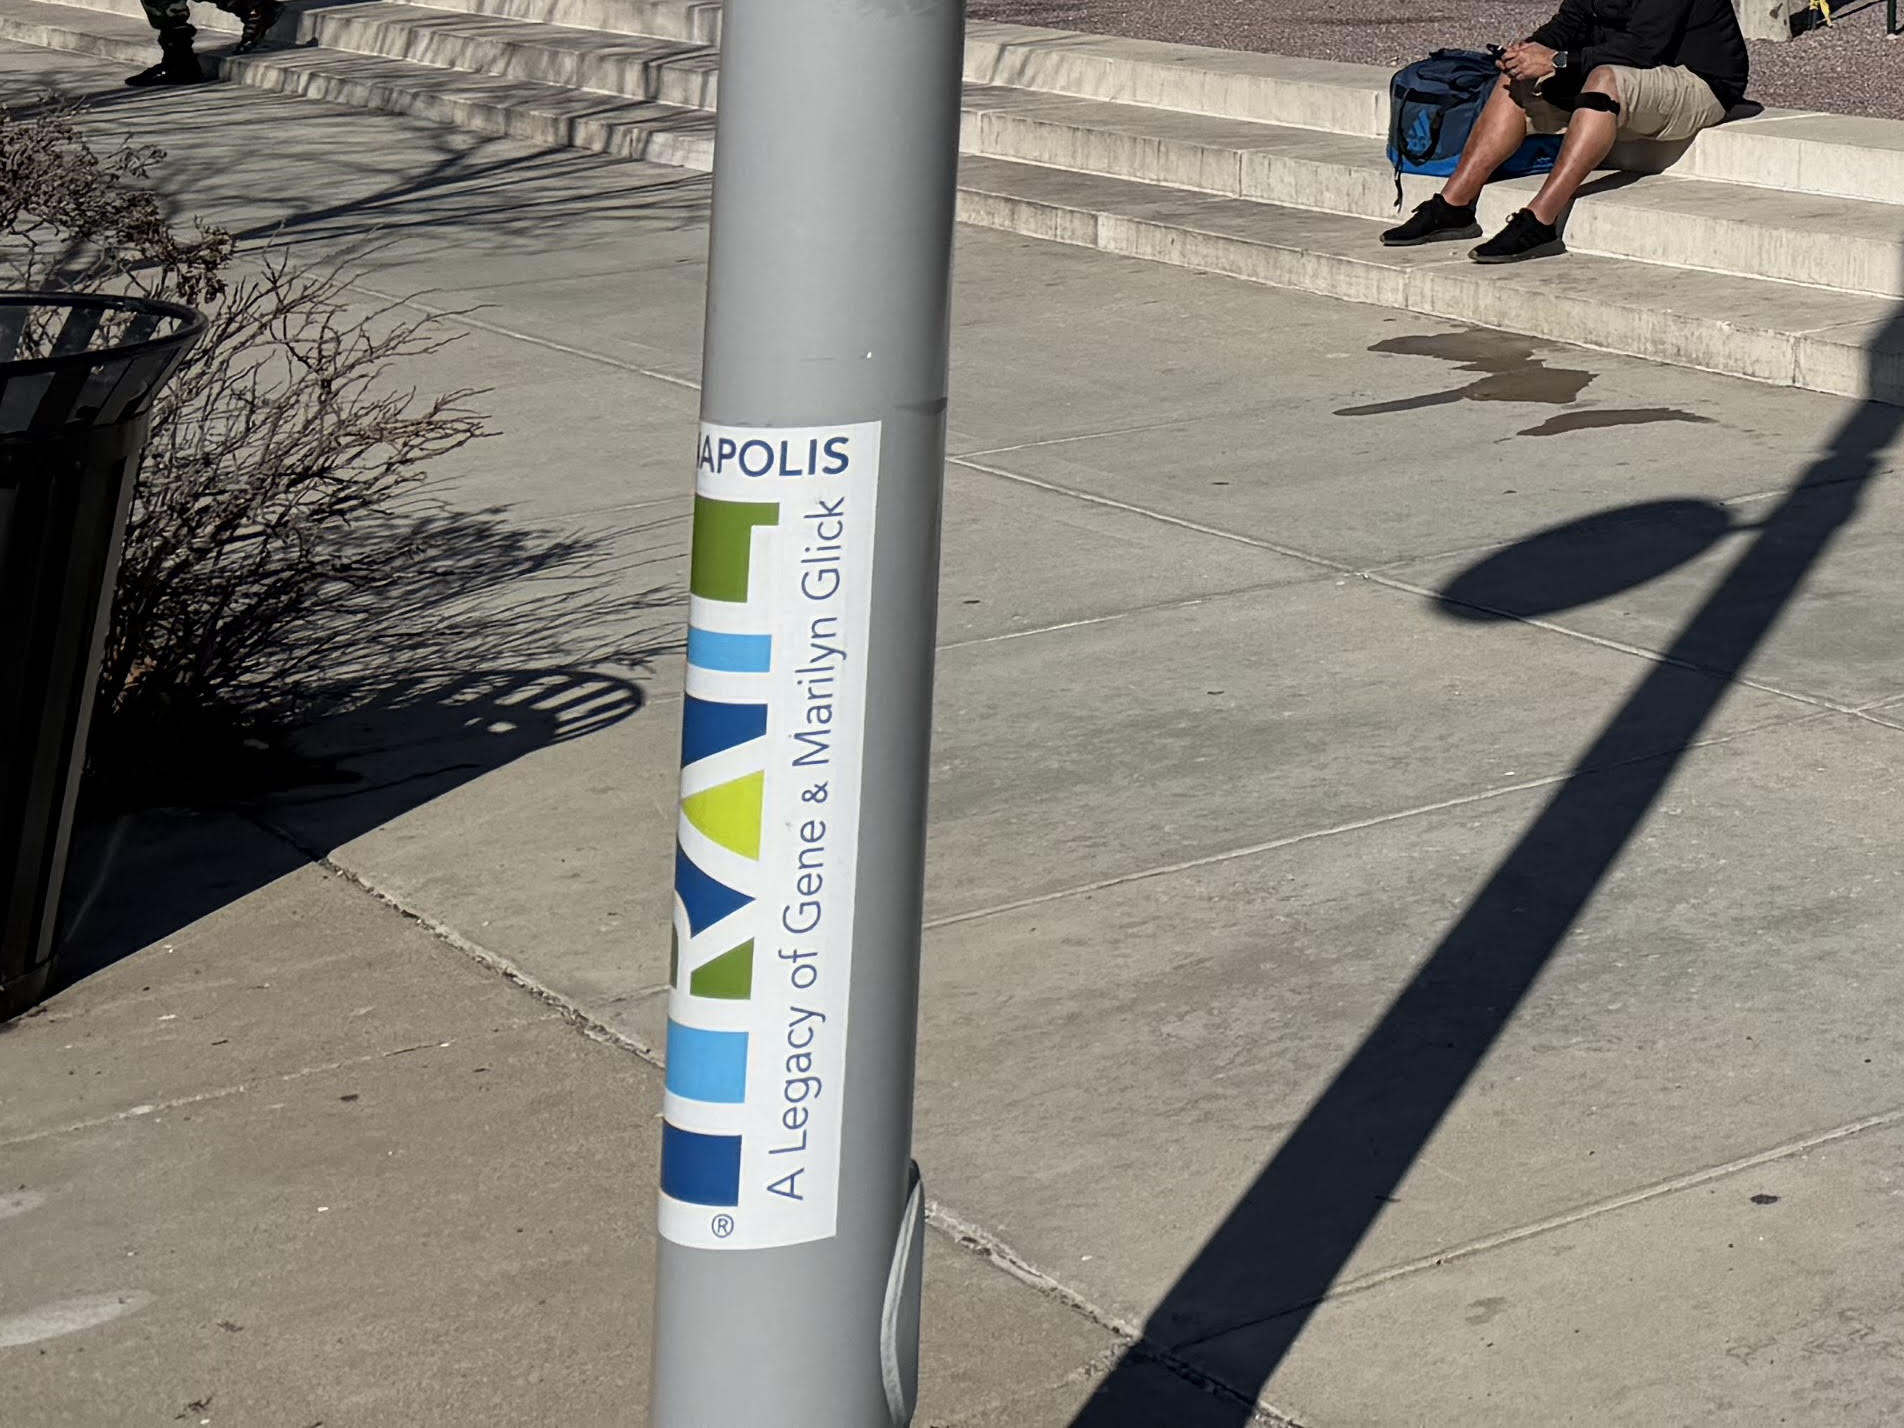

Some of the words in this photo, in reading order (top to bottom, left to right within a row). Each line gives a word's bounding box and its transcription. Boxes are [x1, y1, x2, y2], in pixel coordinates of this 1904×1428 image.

[696, 432, 850, 478] APOLIS
[800, 495, 845, 601] Glick
[791, 616, 847, 768] Marilyn
[801, 782, 829, 804] &
[782, 820, 828, 934] Gene
[778, 949, 818, 989] of
[768, 1006, 826, 1155] Legacy
[766, 1167, 805, 1201] A
